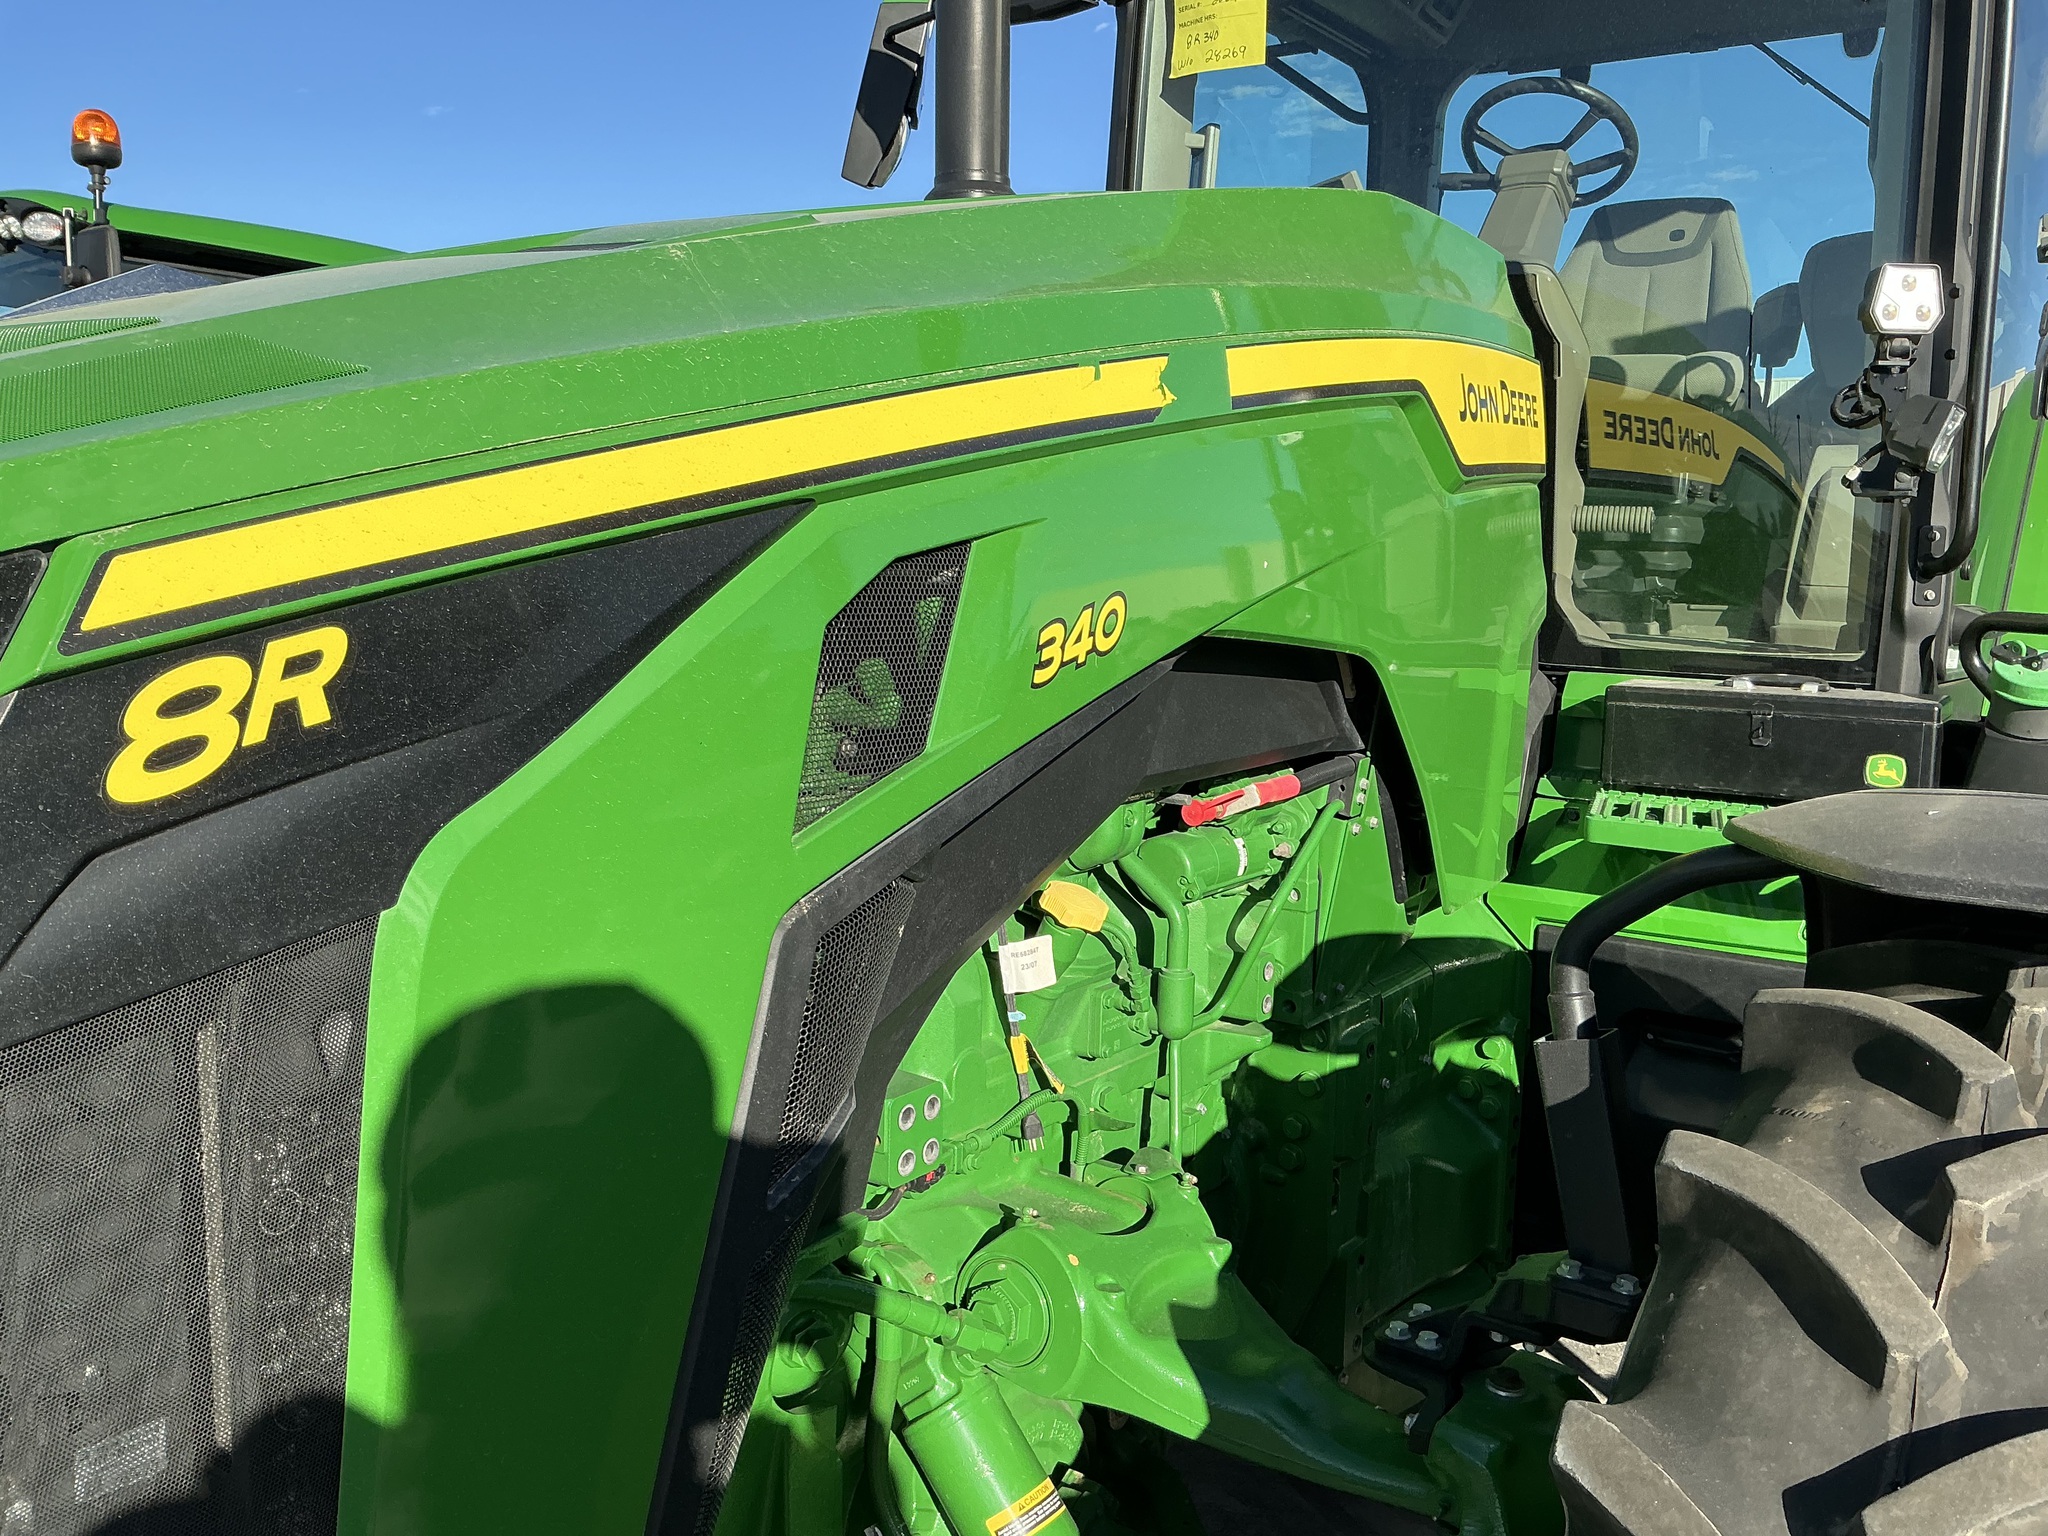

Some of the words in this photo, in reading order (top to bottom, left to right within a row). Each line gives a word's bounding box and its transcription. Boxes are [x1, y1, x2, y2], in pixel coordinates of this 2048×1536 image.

[1178, 3, 1196, 13] SERIAL
[1178, 15, 1203, 29] MACHINE
[1459, 373, 1499, 424] JOHN
[1500, 380, 1539, 428] DEERE
[1032, 593, 1127, 688] 340
[105, 625, 348, 804] 8R
[1024, 1484, 1050, 1507] CAUTION
